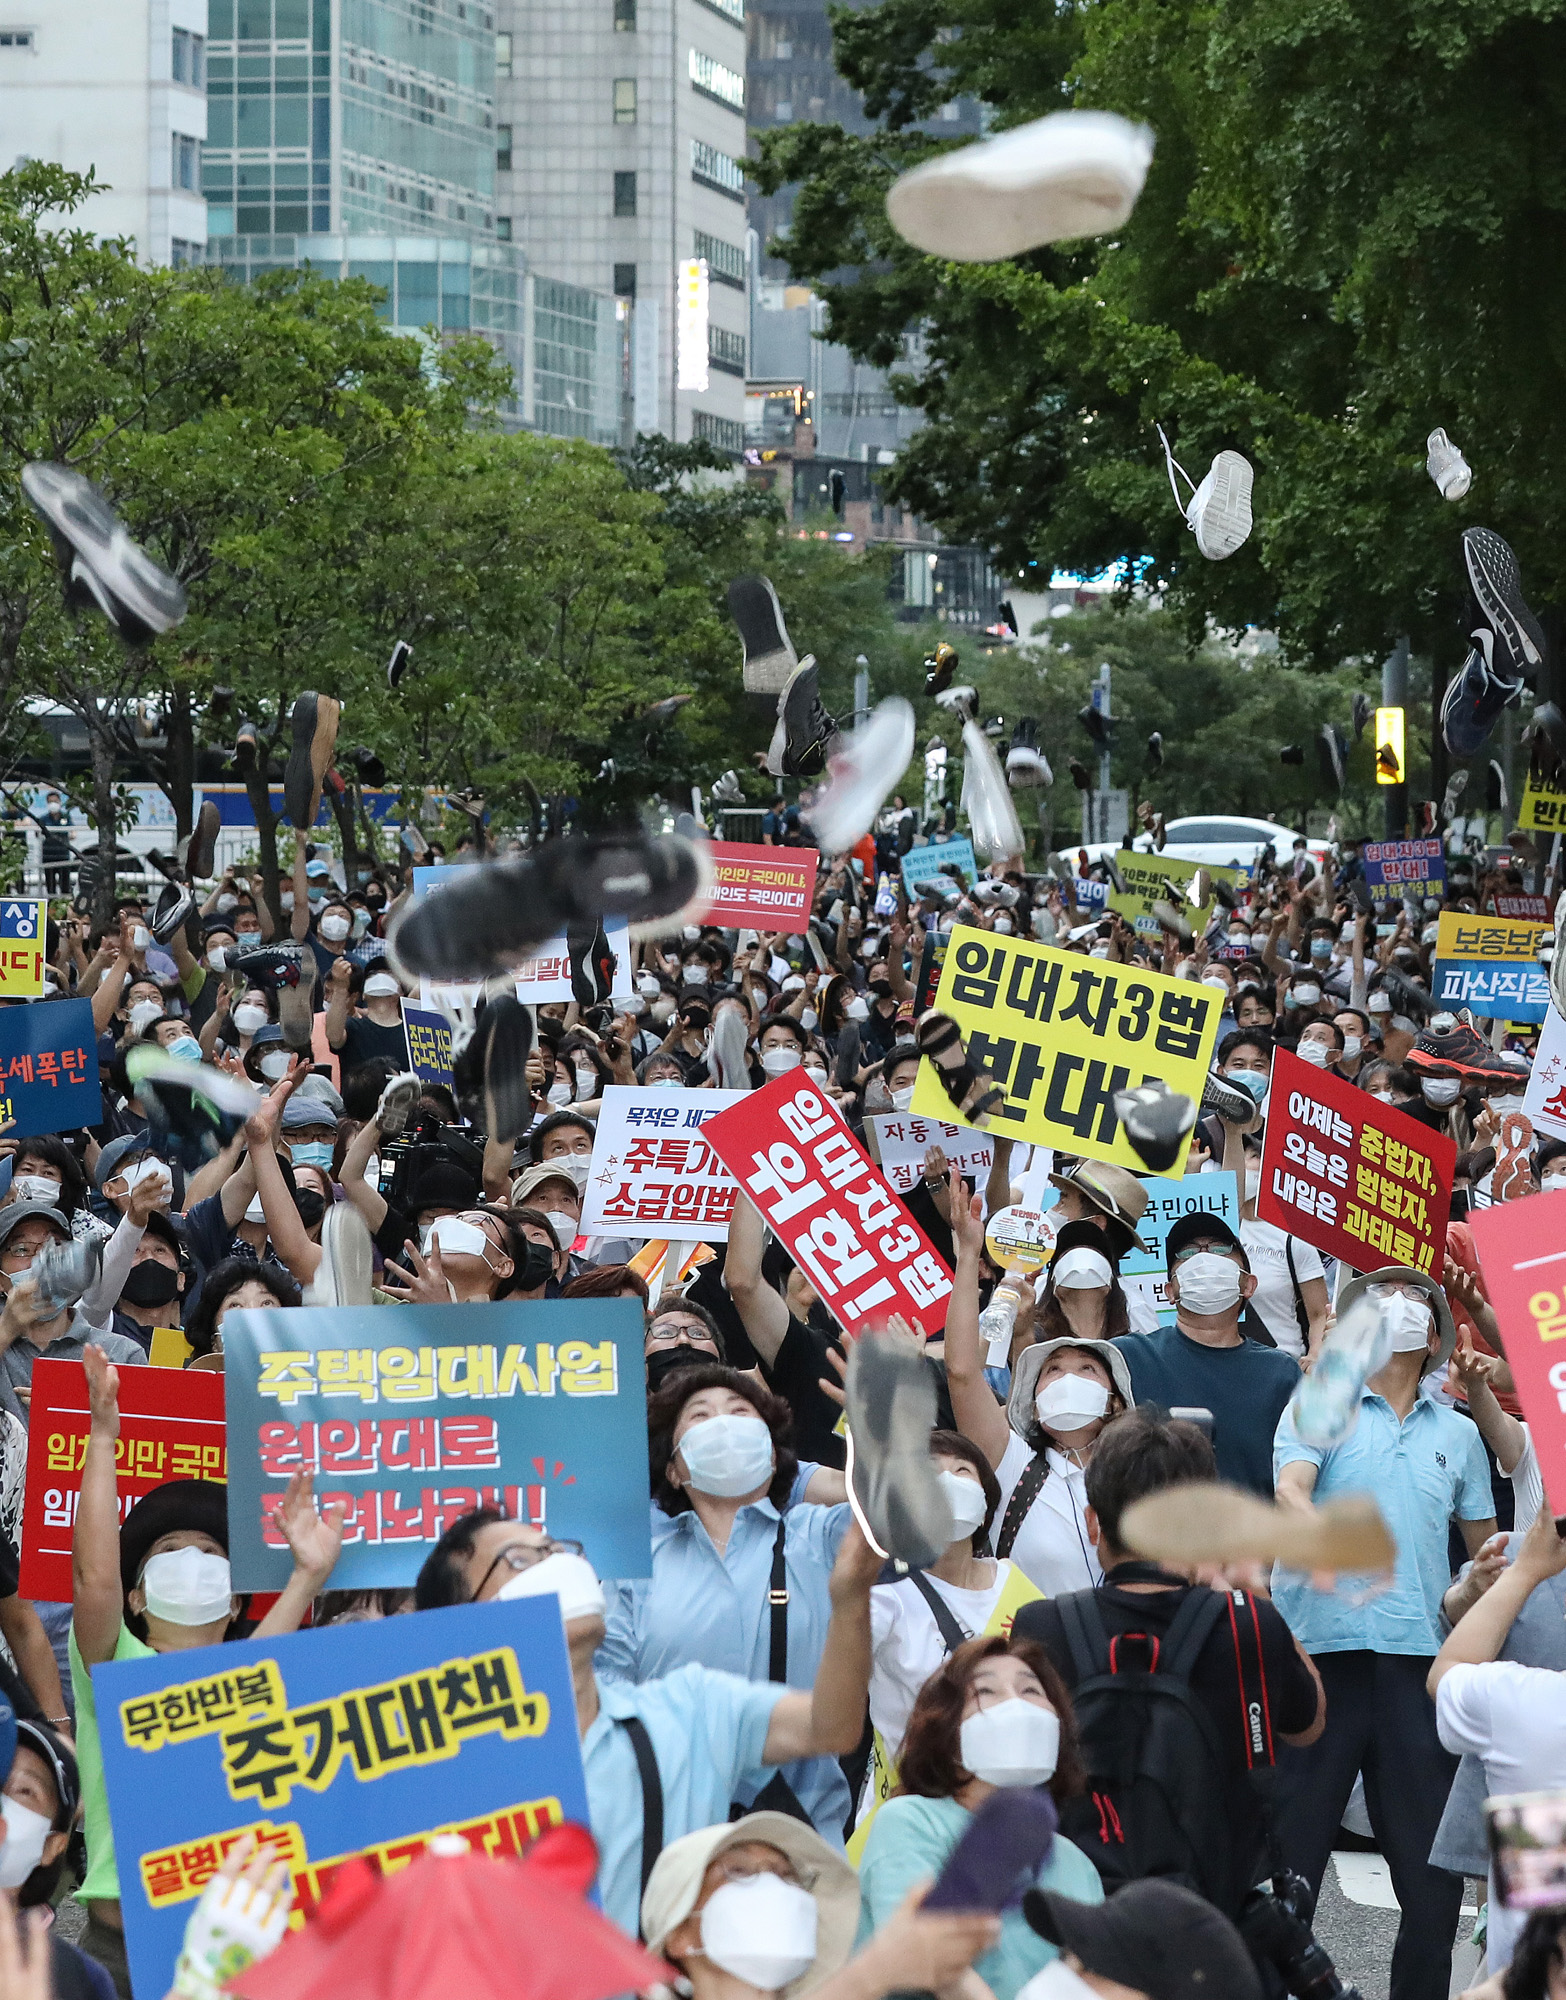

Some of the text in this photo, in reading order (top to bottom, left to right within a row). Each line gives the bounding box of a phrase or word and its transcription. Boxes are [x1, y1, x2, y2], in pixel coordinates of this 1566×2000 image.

[714, 866, 751, 884] 차인만
[748, 888, 805, 907] 국민이다!
[1382, 860, 1429, 882] 반대!
[951, 942, 1209, 1060] 임대차3법
[1441, 971, 1551, 1003] 파산직결
[626, 1107, 679, 1128] 목적은
[969, 1030, 1162, 1146] 반대
[623, 1138, 733, 1177] 주특기
[884, 1121, 929, 1143] 자동
[1288, 1091, 1438, 1196] 어제는 준법자,
[602, 1182, 740, 1222] 소급입법
[778, 1089, 953, 1310] 임대차3법
[1143, 1194, 1229, 1222] 국민이냐
[1283, 1132, 1432, 1237] 오늘은 범법자,
[745, 1141, 898, 1321] 위헌!
[1272, 1167, 1435, 1275] 내일은 과태료!!
[257, 1340, 618, 1406] 주택임대사업
[258, 1414, 501, 1478] 원안대로
[124, 1667, 274, 1741] 무한반복
[223, 1655, 538, 1799] 주거대책,
[1248, 1702, 1264, 1753] Canon
